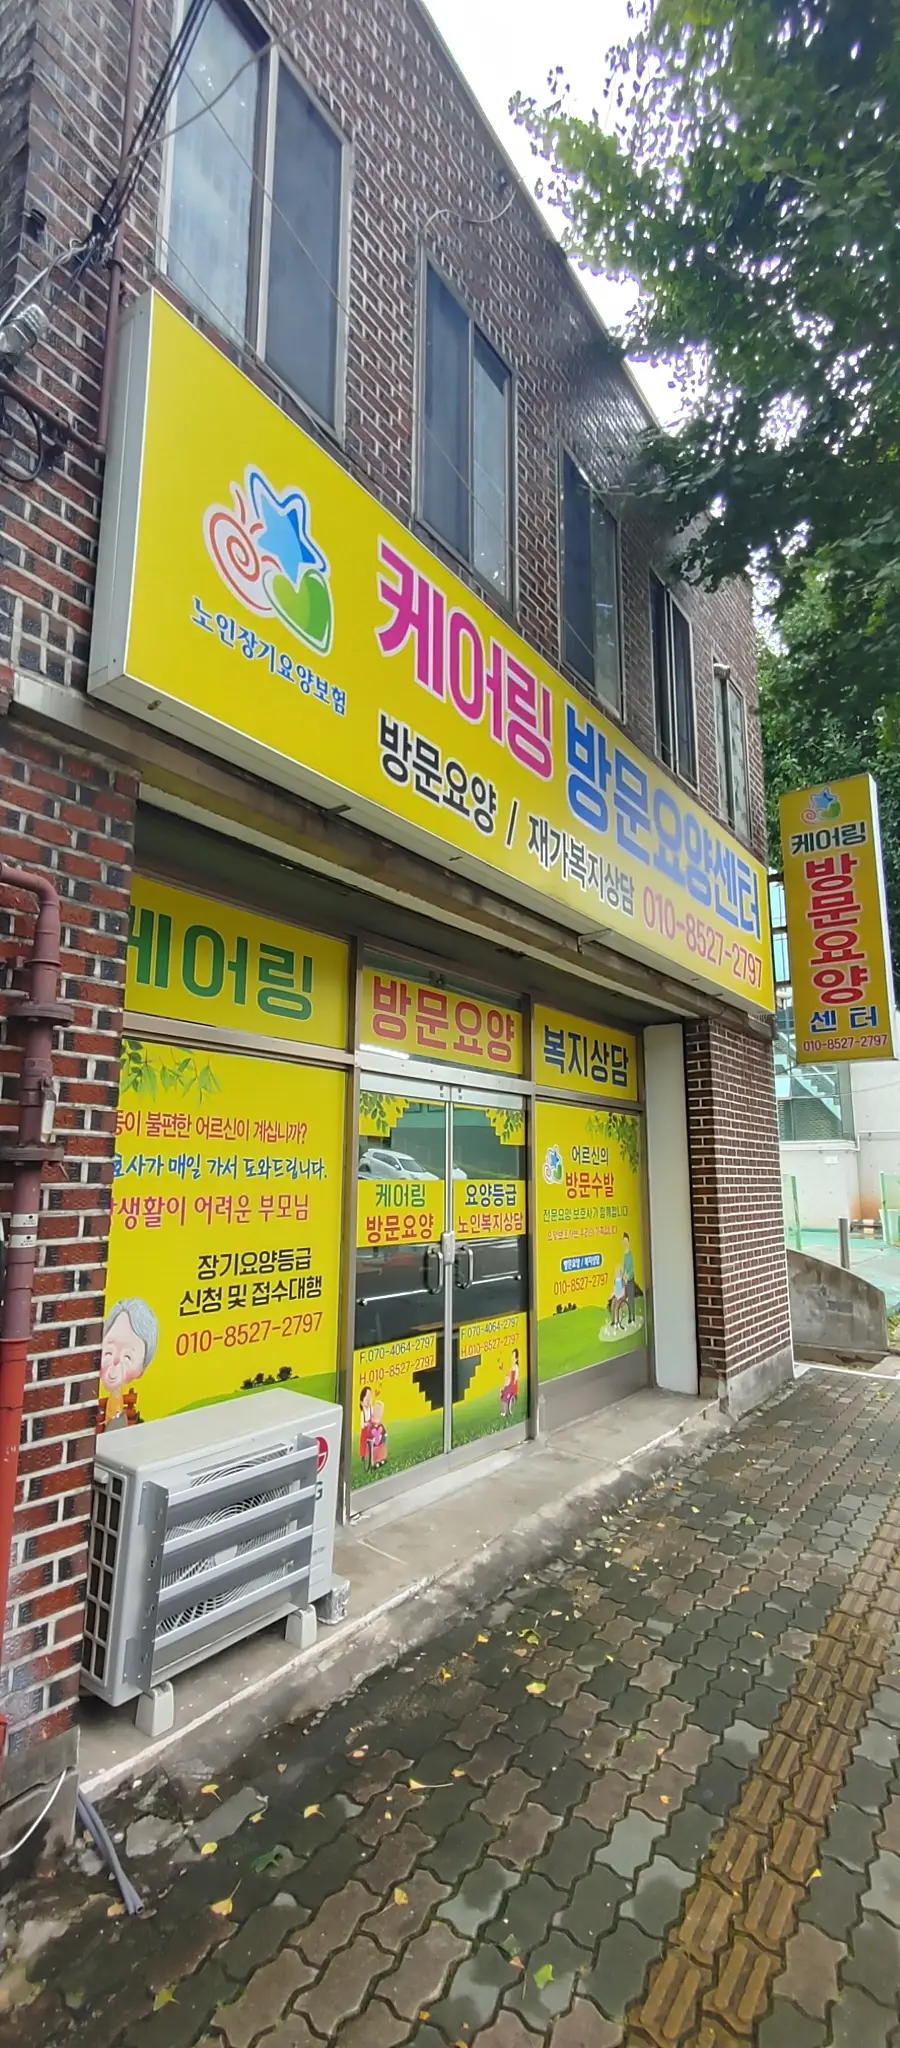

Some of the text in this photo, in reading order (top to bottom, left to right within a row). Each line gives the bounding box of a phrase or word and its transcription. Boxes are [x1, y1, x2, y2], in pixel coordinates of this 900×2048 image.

[191, 596, 347, 716] 노인장기요양보험
[376, 535, 762, 941] 케어링 방문요양센터
[379, 709, 497, 837] 방문요양
[527, 815, 635, 918] 재가복지상담
[642, 885, 763, 991] 010-8527-2797
[790, 821, 867, 855] 케어링
[805, 853, 869, 1005] 방문요양
[372, 974, 516, 1064] 방문요양
[543, 1024, 629, 1088] 복지상담
[803, 1034, 888, 1052] 010-8527-2797
[145, 1111, 192, 1138] 불편한
[196, 1115, 249, 1142] 어르신이
[253, 1120, 308, 1144] 계십니까?
[168, 1153, 201, 1180] 매일
[206, 1154, 237, 1180] 가서
[242, 1155, 328, 1181] 도와드립니다.
[571, 1145, 609, 1166] 어르신의
[375, 1183, 426, 1208] 케어링
[465, 1183, 517, 1207] 요양등급
[565, 1171, 615, 1199] 방문수발
[109, 1194, 308, 1230] 생활이 어려운 부모님
[457, 1212, 524, 1235] 노인복지상담
[366, 1213, 434, 1244] 방문요양
[197, 1247, 312, 1281] 장기요양등급
[179, 1275, 323, 1318] 신청 및 접수대행
[553, 1273, 609, 1296] 010-8527-2797
[175, 1311, 324, 1357] 010-8527-2797
[460, 1317, 519, 1340] F.070-4064-2797
[359, 1335, 435, 1365] F.070-4064-2797
[460, 1333, 519, 1357] H.010-8527-2797
[359, 1354, 435, 1385] H.010-8527-2797
